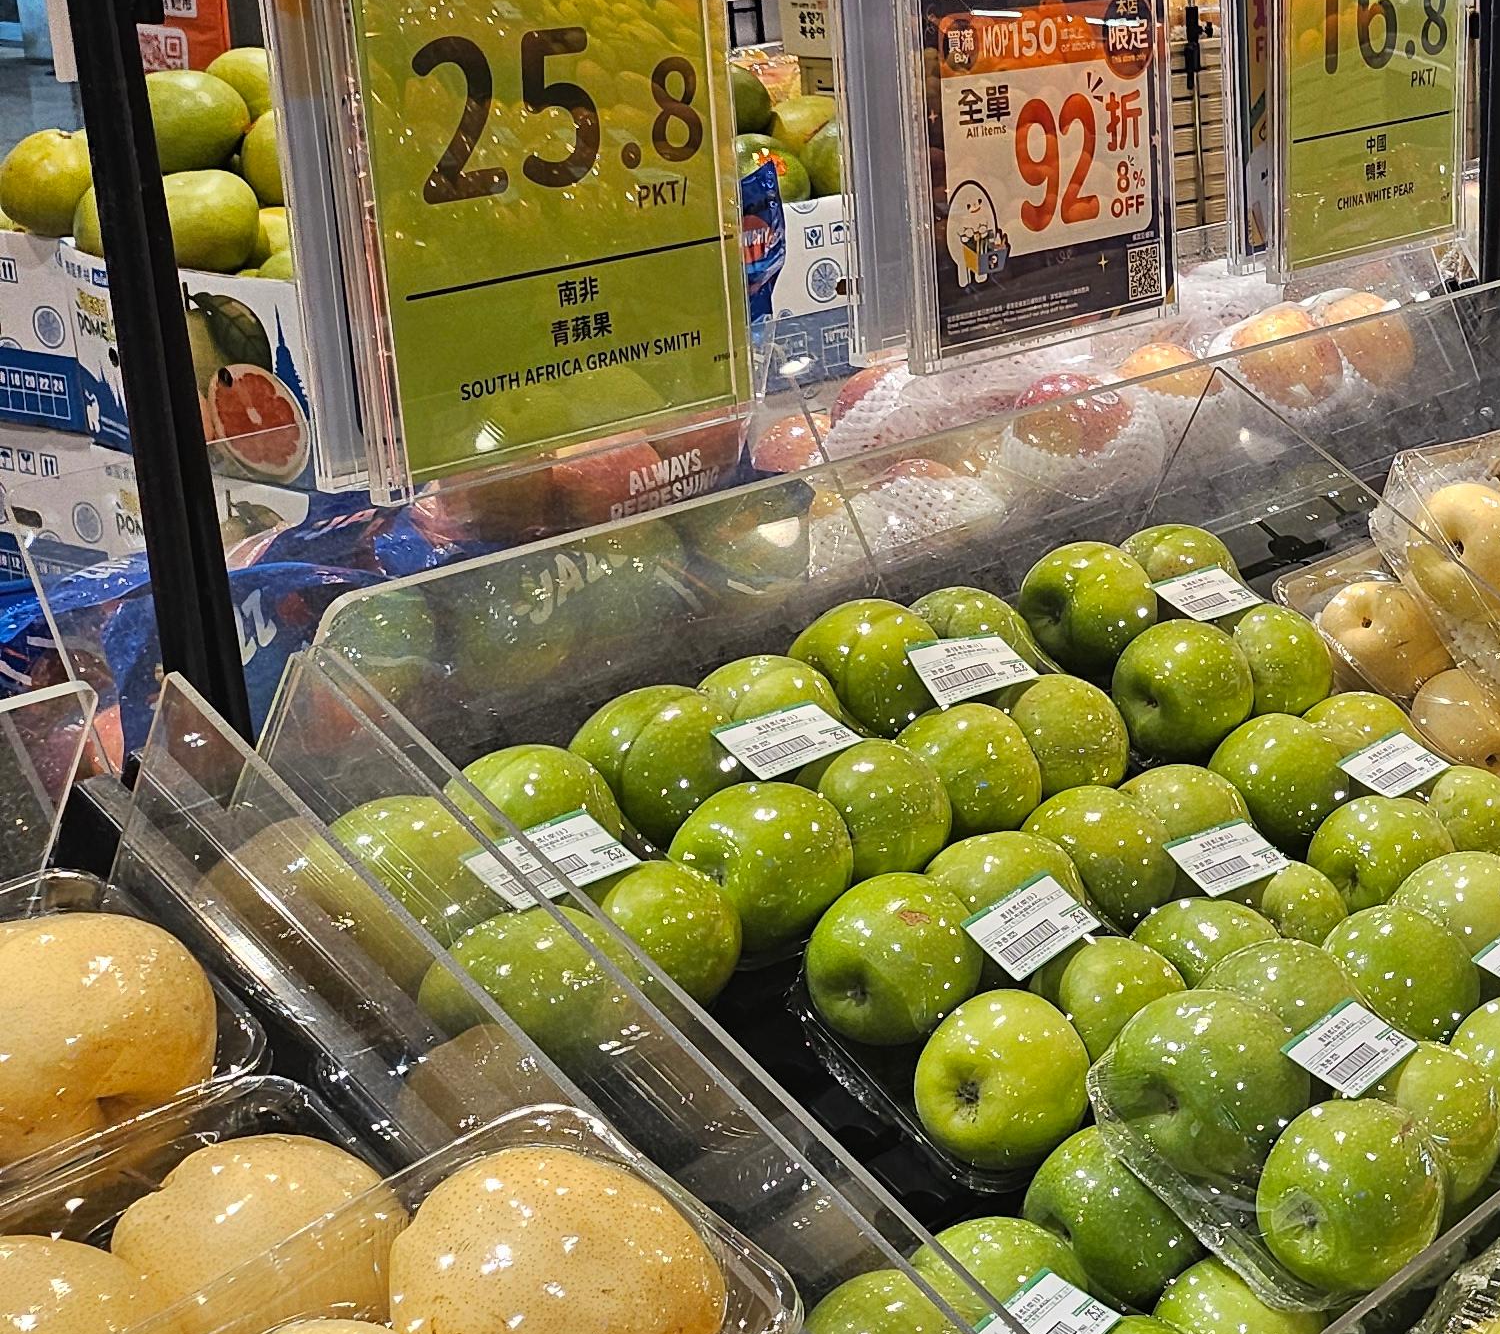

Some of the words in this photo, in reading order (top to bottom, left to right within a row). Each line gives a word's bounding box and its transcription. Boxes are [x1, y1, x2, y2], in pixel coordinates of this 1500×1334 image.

[947, 29, 974, 53] 買滿
[1108, 19, 1149, 51] 限定
[954, 51, 969, 64] Buy
[1410, 67, 1437, 88] PKT/
[411, 26, 703, 205] 25.8
[958, 84, 1011, 126] 全單
[1105, 89, 1143, 152] 折
[966, 127, 979, 139] All
[981, 123, 1007, 138] items
[1366, 134, 1387, 154] 中國
[1015, 92, 1101, 233] 92
[1365, 161, 1387, 182] 鴨梨
[637, 179, 688, 210] PKT/
[1111, 194, 1146, 219] OFF
[1337, 191, 1364, 211] CHINA
[1364, 186, 1392, 204] WHITE
[1393, 182, 1414, 198] PEAR
[558, 277, 600, 308] 南非
[550, 311, 613, 347] 青蘋果
[460, 373, 522, 403] SOUTH
[524, 357, 583, 388] AFRICA
[586, 342, 650, 370] GRANNY
[654, 330, 701, 356] SMITH
[628, 449, 701, 496] ALWAYS
